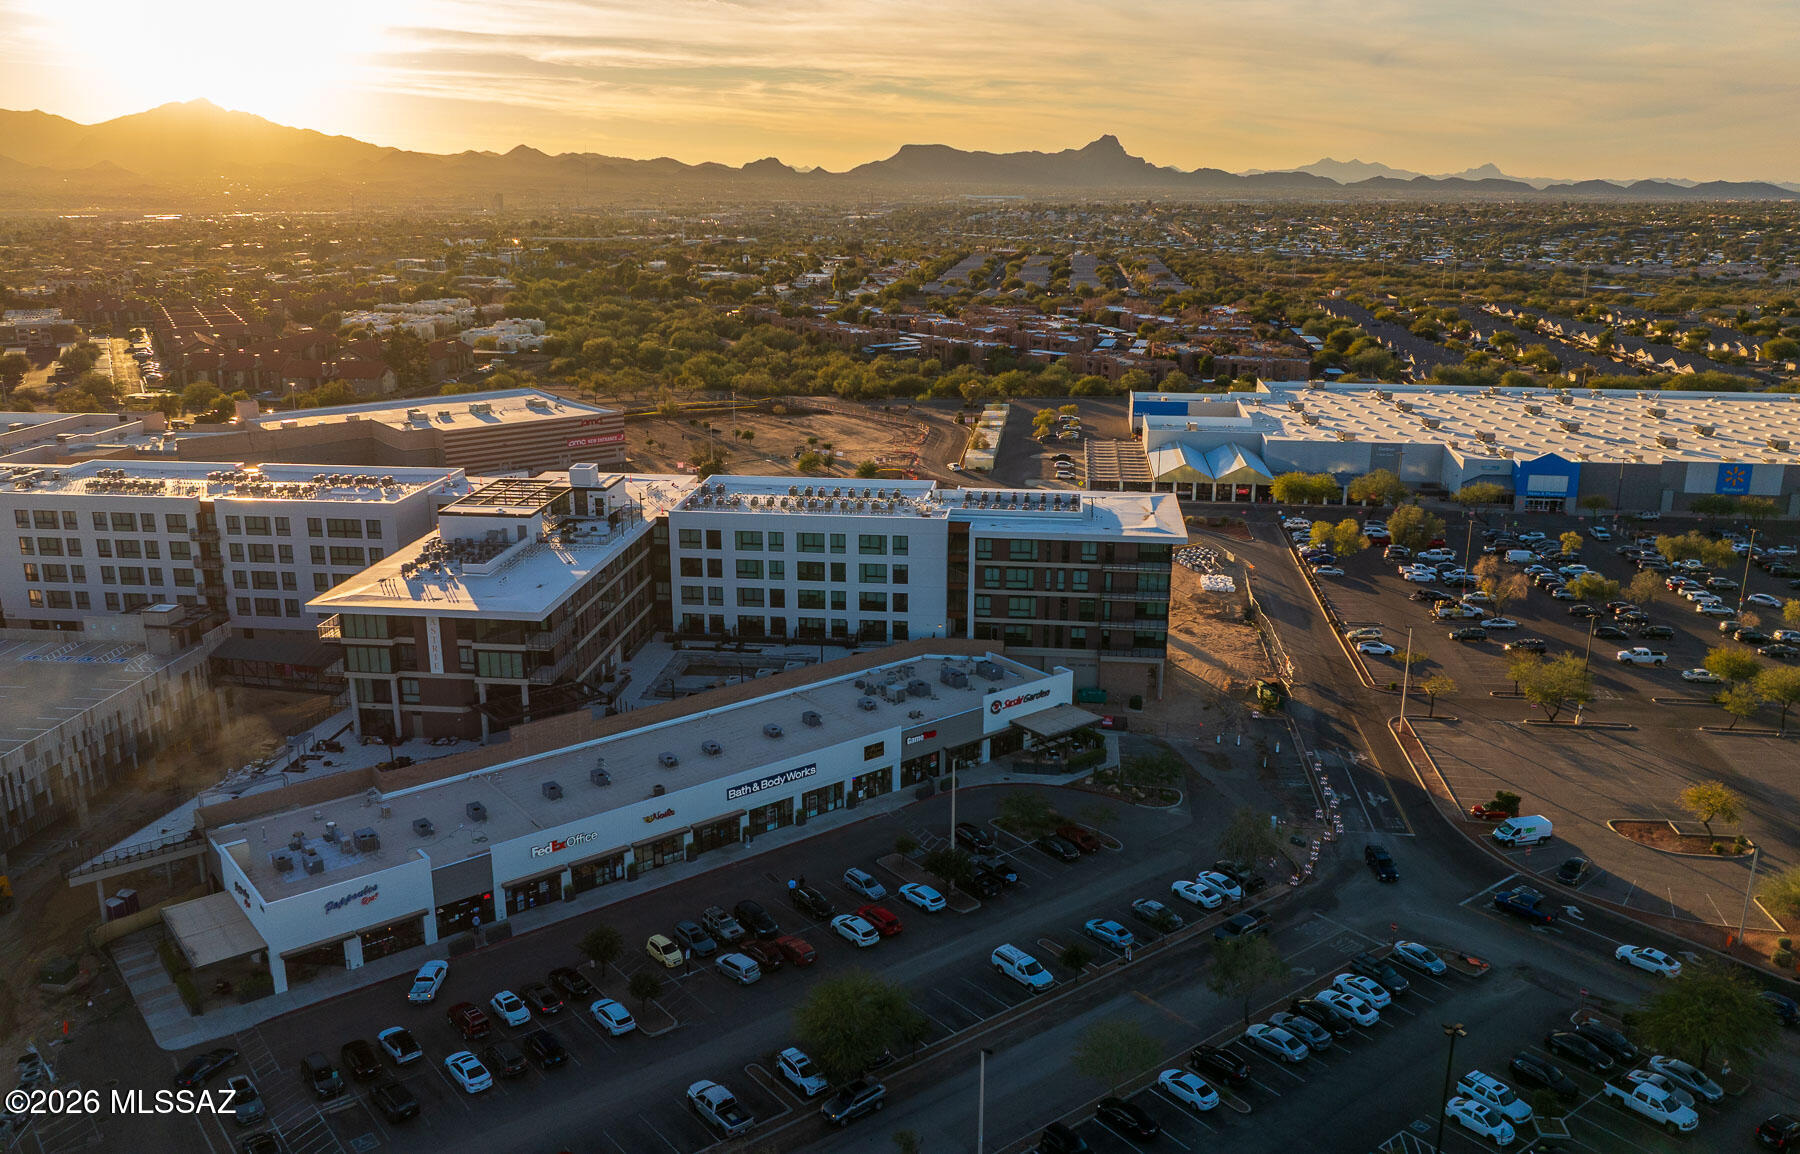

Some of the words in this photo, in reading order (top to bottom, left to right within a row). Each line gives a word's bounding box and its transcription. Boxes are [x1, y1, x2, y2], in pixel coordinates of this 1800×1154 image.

[568, 439, 587, 447] amc
[1023, 689, 1051, 703] Garden
[906, 730, 937, 745] Game
[728, 785, 751, 799] Bath
[752, 783, 760, 792] &
[761, 775, 786, 789] Body
[786, 766, 816, 781] Works
[531, 840, 567, 858] FedEx
[566, 831, 598, 847] Office
